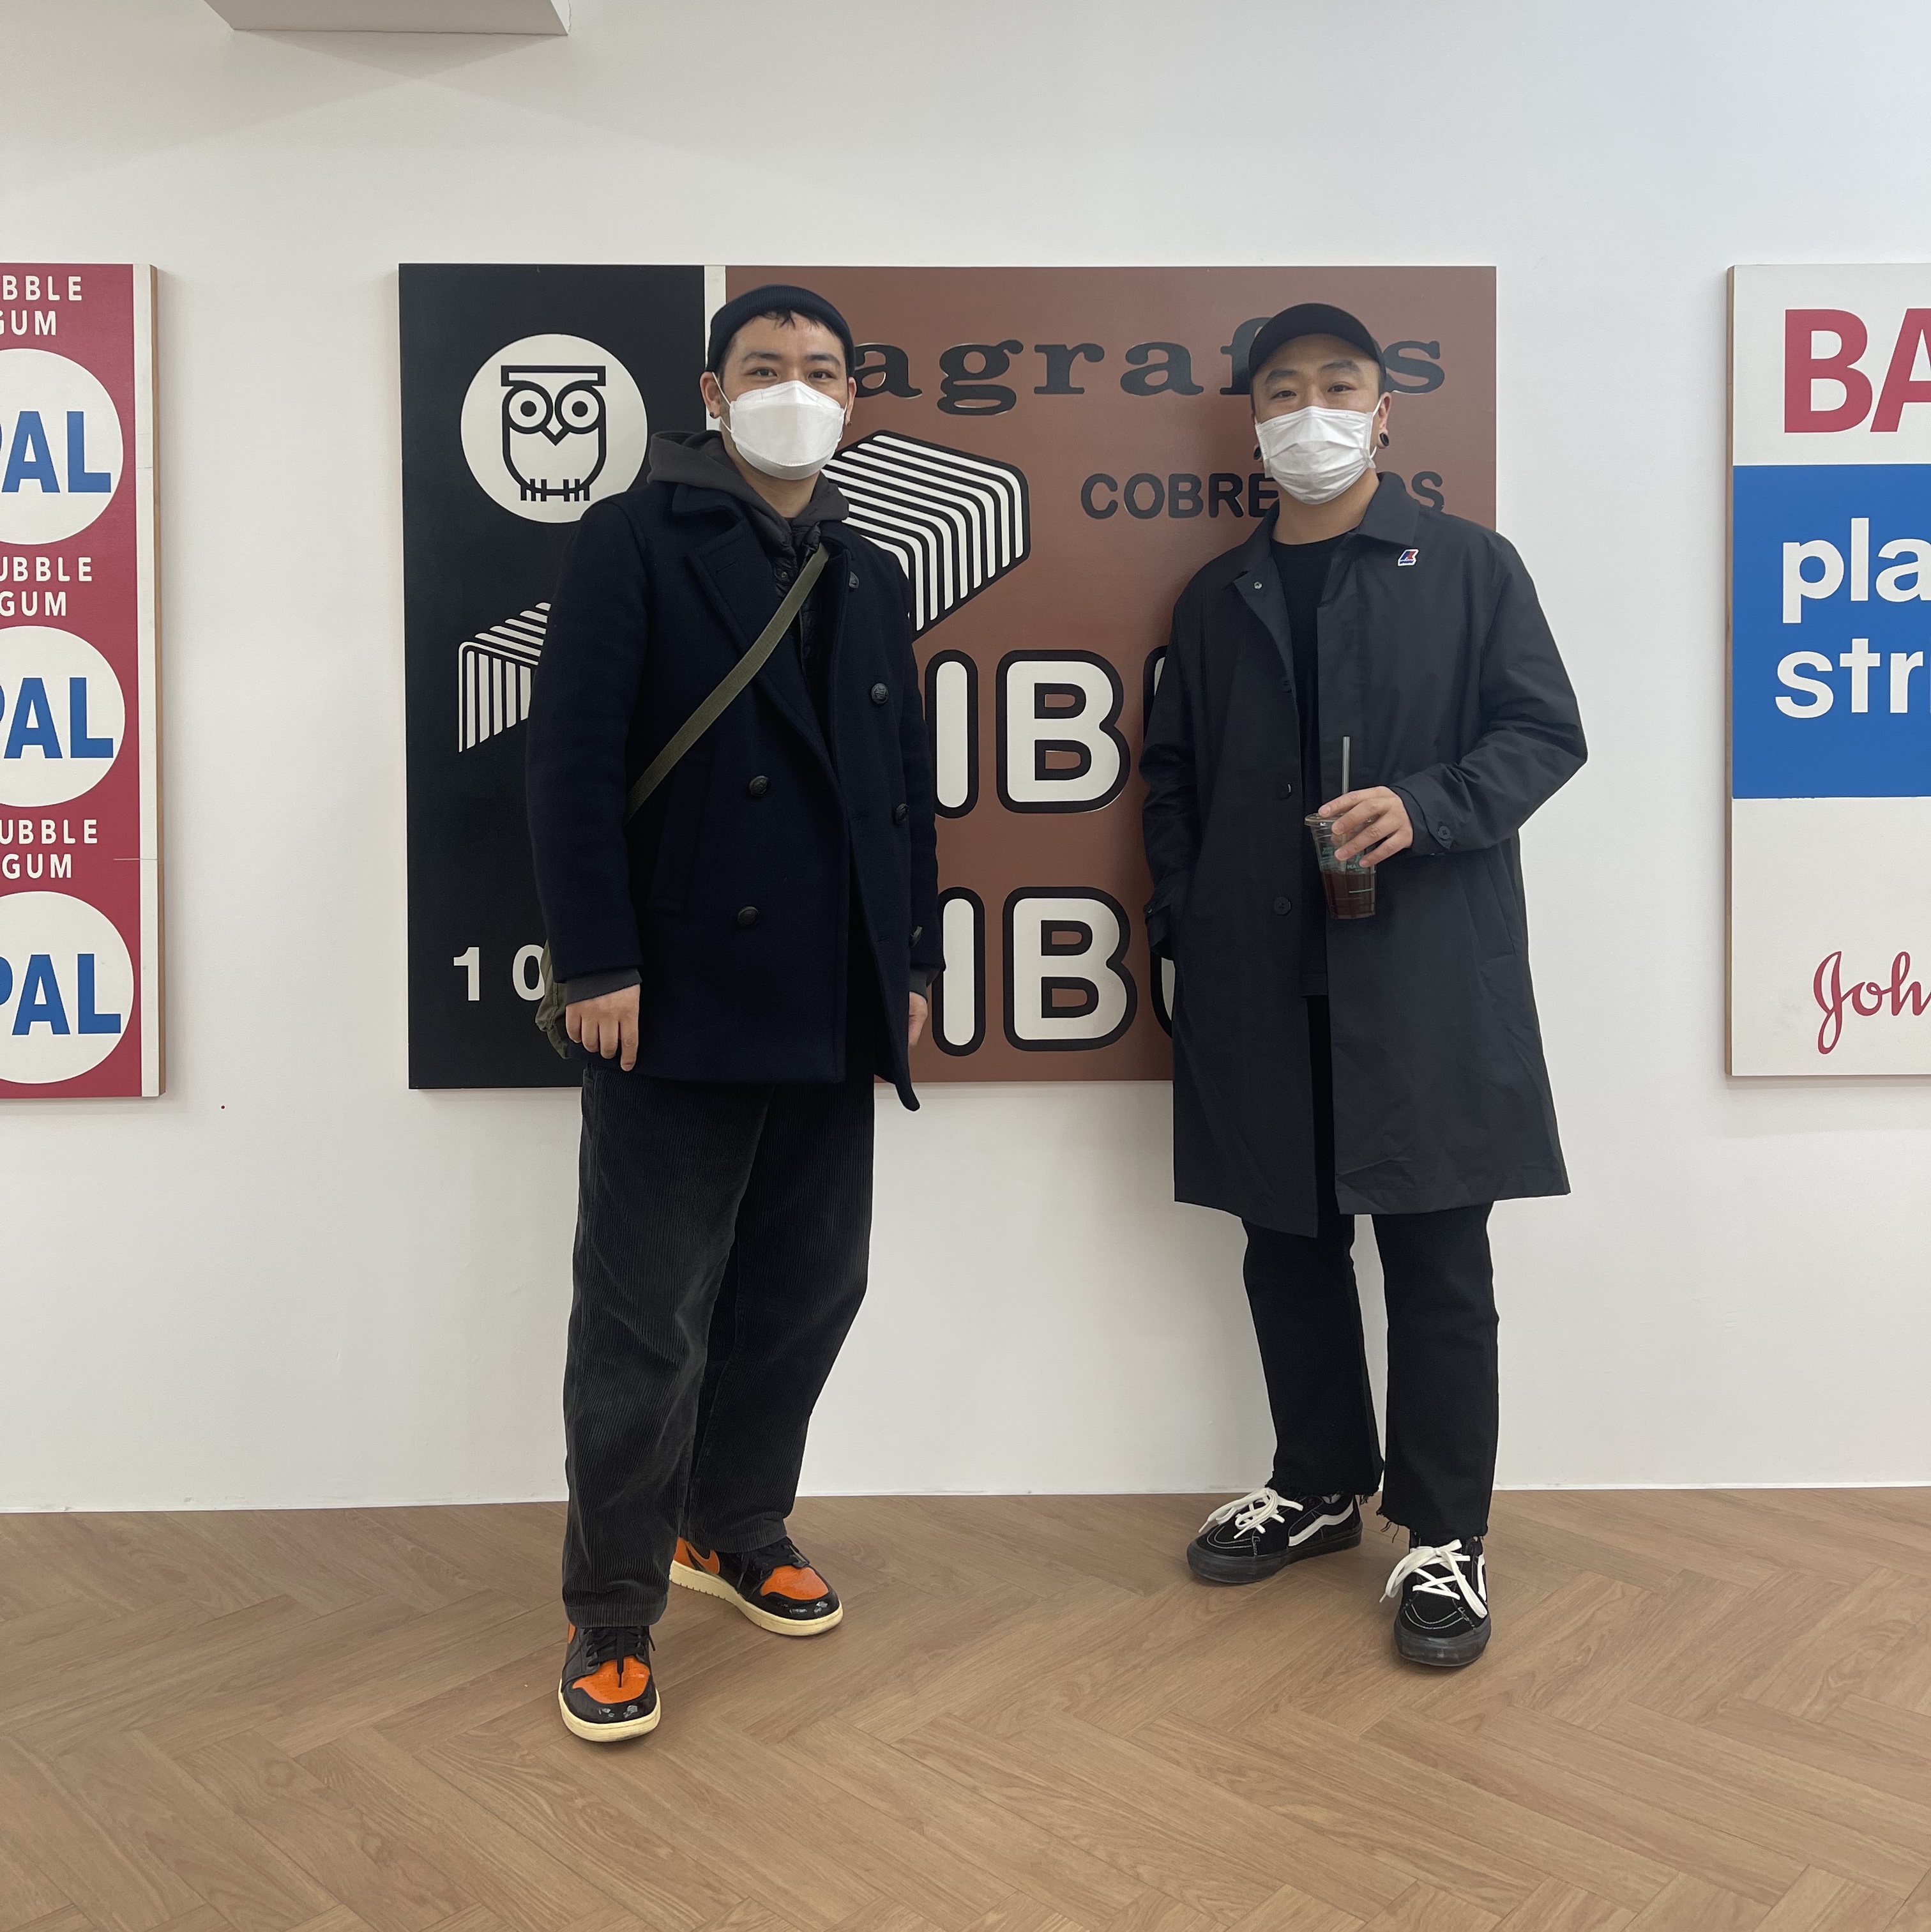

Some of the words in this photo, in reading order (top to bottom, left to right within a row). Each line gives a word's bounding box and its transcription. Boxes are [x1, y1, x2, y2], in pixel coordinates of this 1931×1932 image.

[0, 309, 56, 336] UM
[0, 411, 111, 494] AL
[1782, 517, 1931, 624] pla
[0, 590, 66, 617] GUM
[0, 677, 114, 759] AL
[0, 819, 98, 845] UBBLE
[2, 853, 72, 879] GUM
